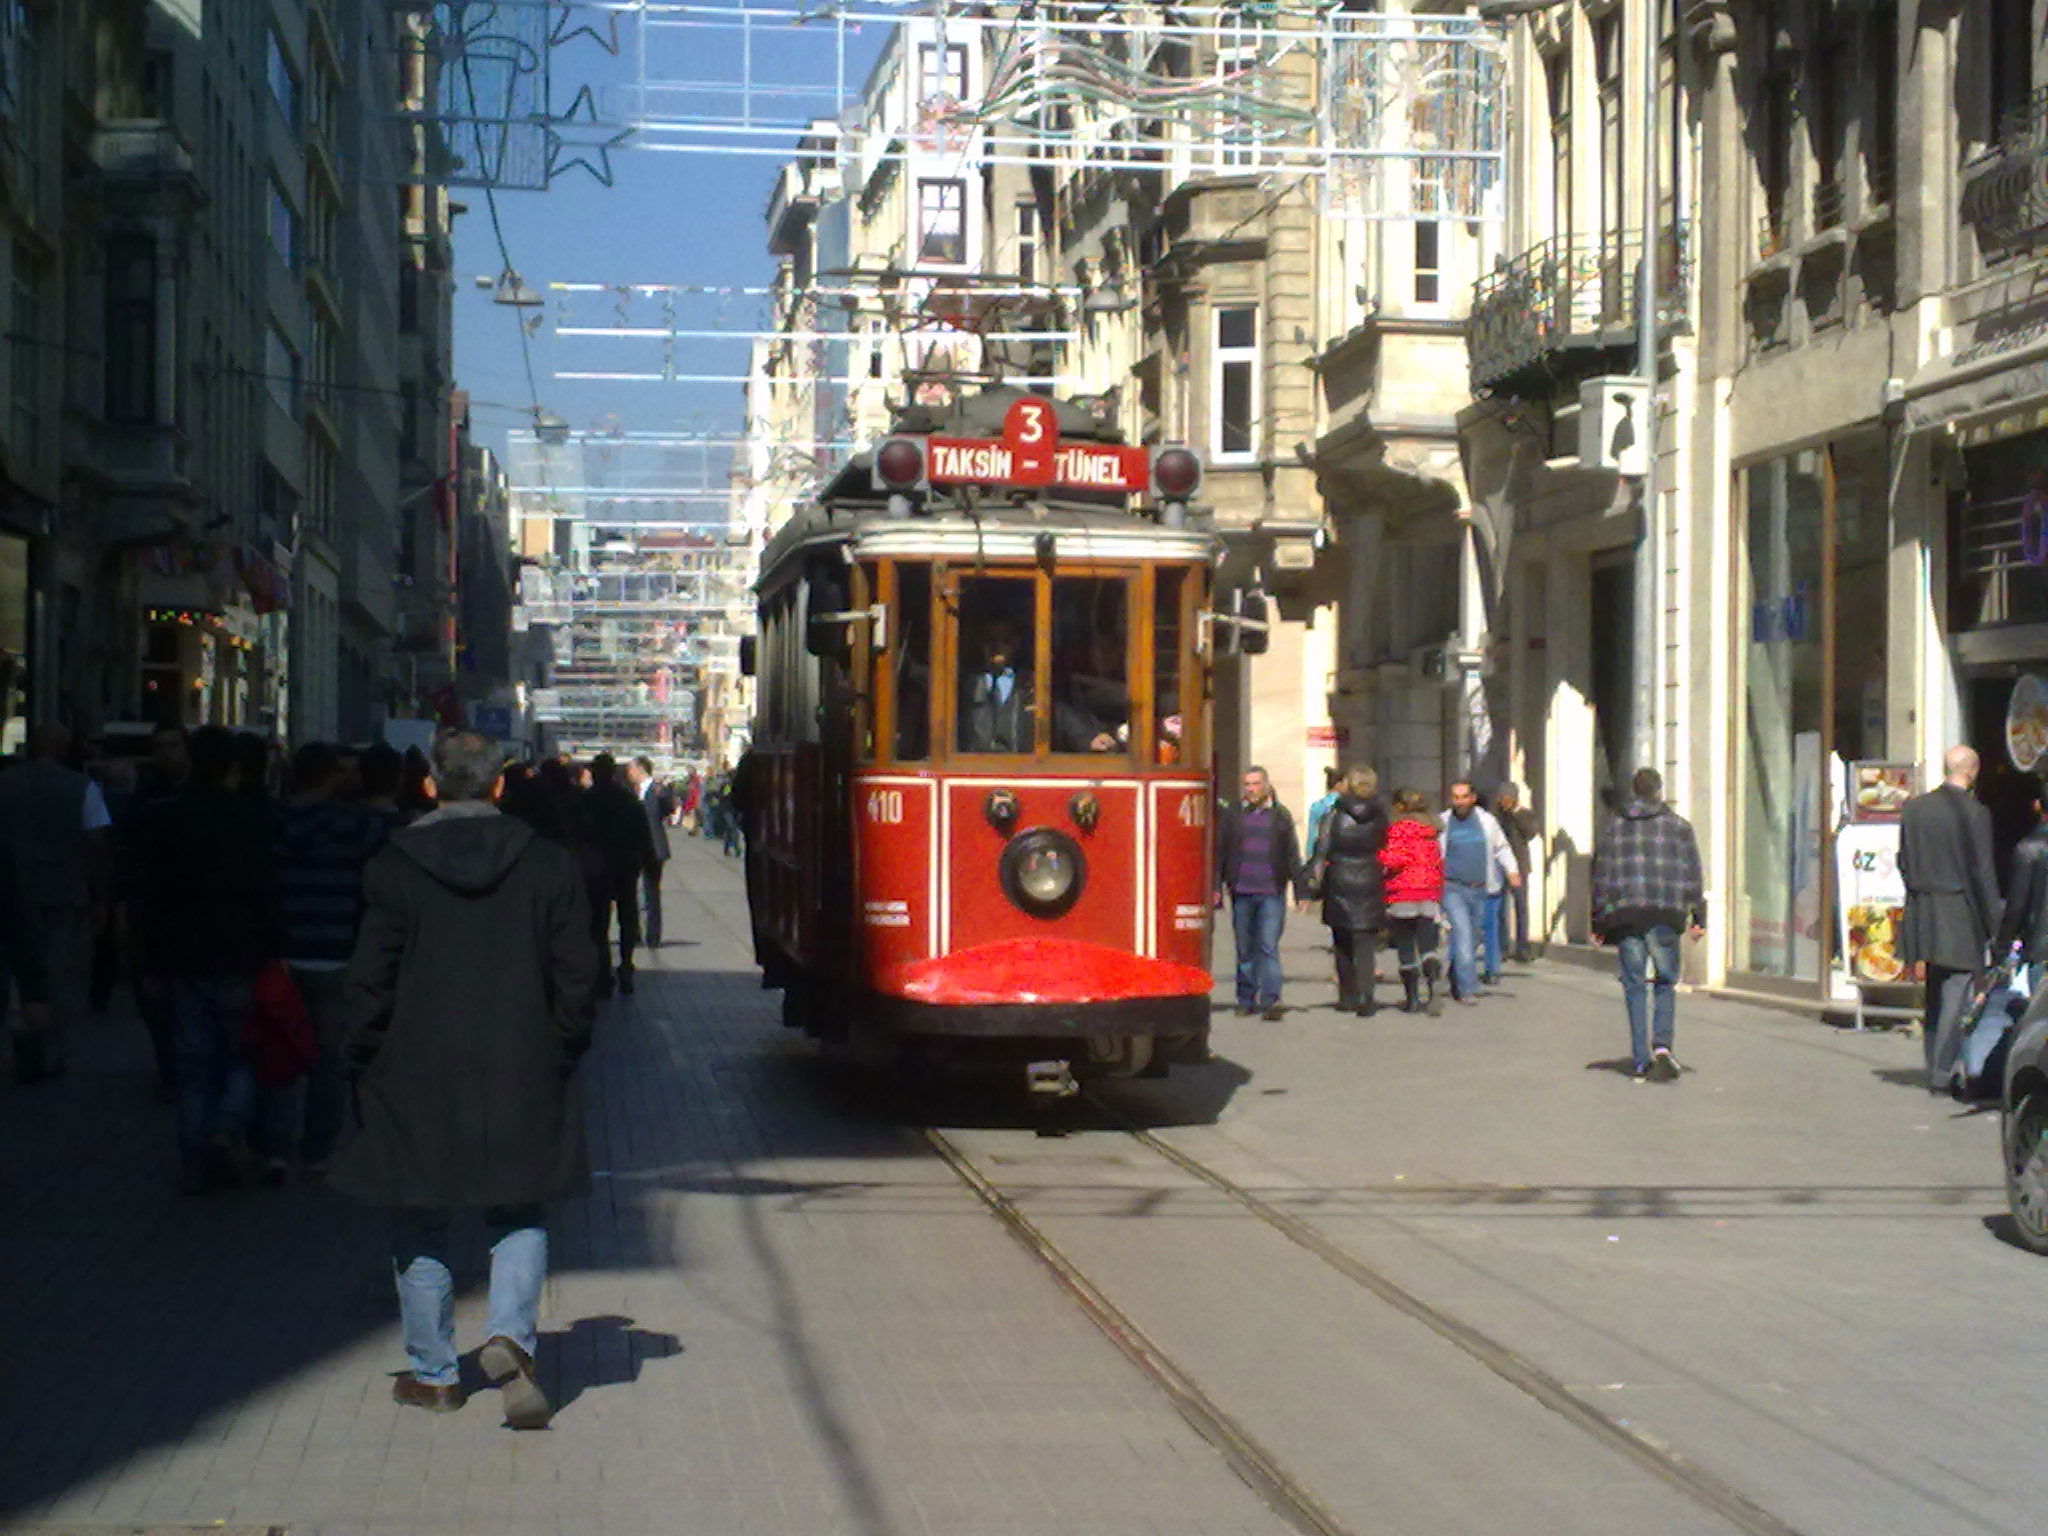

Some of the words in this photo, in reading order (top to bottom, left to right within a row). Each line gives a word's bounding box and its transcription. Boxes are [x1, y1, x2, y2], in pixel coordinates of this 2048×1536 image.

[1020, 406, 1043, 442] 3
[1053, 447, 1127, 485] TÜNEL
[868, 790, 903, 824] 410
